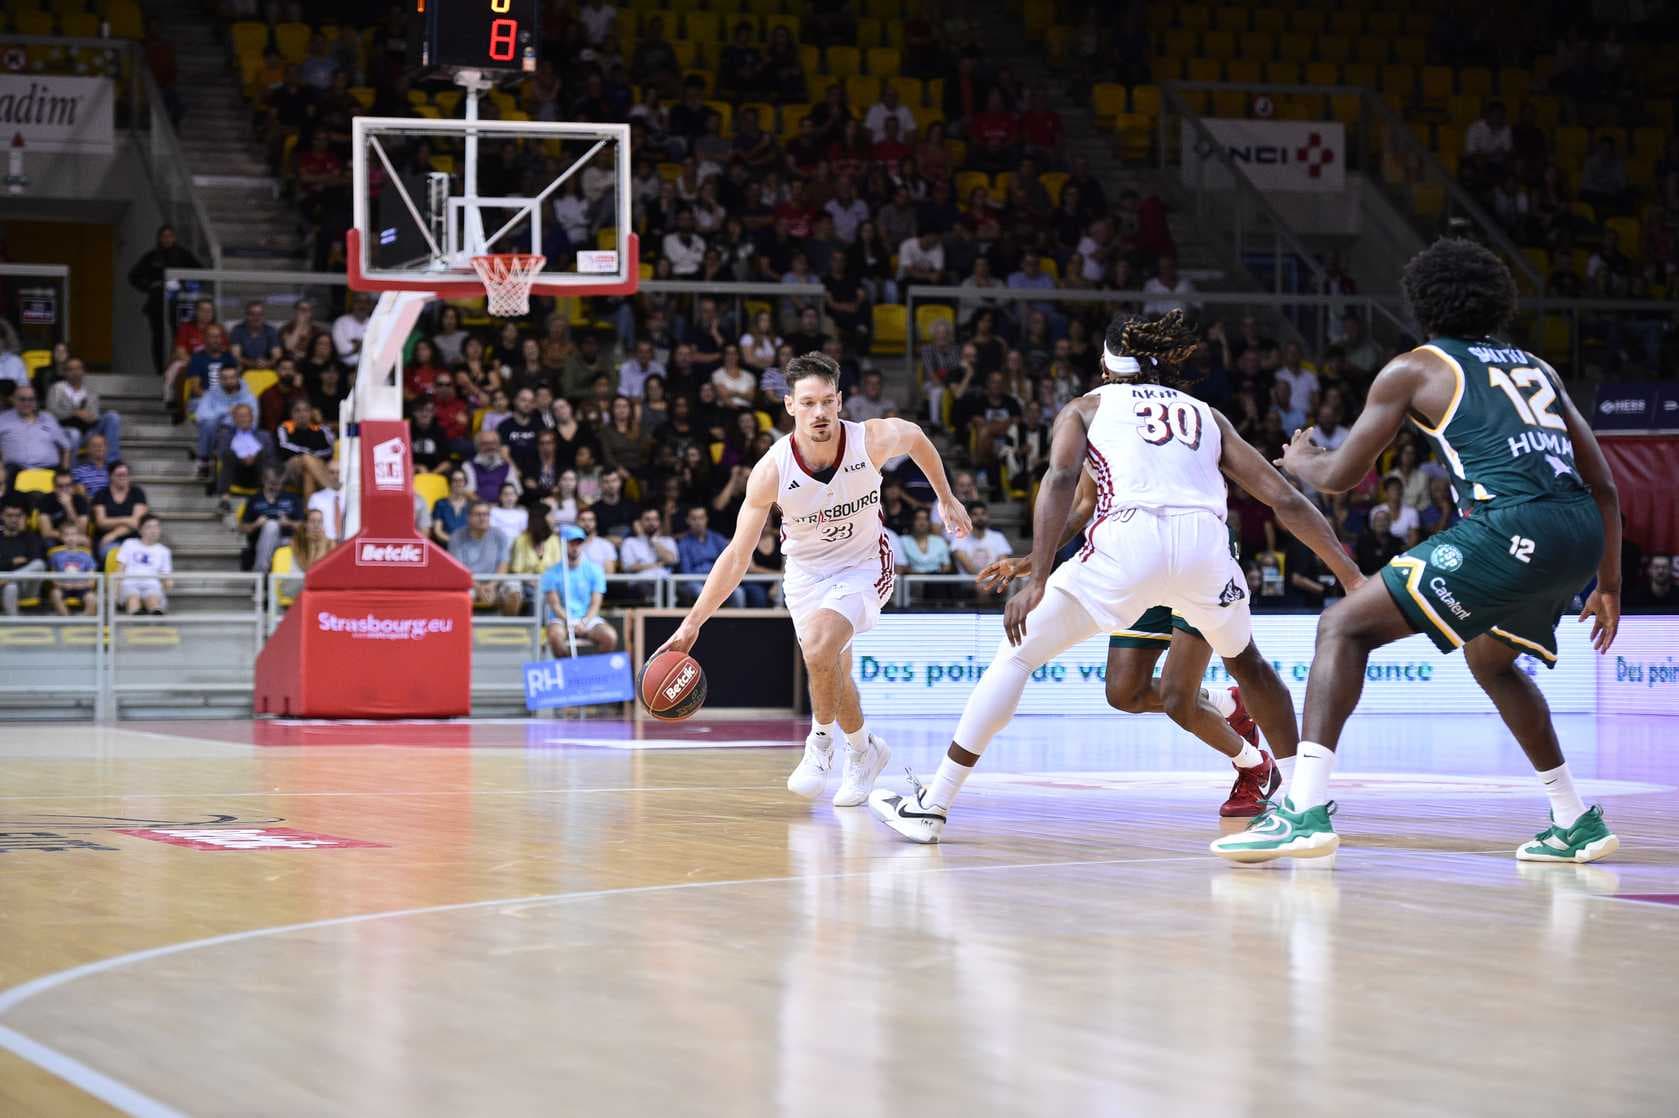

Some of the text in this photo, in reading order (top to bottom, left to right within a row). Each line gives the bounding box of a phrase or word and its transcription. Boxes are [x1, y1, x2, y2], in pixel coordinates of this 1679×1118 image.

[489, 19, 517, 60] 8
[1488, 366, 1567, 431] 12
[1133, 401, 1202, 451] 30
[851, 462, 866, 472] LCR
[821, 522, 853, 542] 23
[1509, 535, 1535, 563] 12
[1430, 577, 1471, 620] Catalent
[318, 611, 453, 641] Strasbourg.eu
[527, 662, 565, 697] RH
[666, 666, 696, 699] Betclic
[861, 655, 913, 682] Des
[927, 655, 990, 688] poin
[1367, 665, 1433, 682] ance
[1616, 656, 1643, 682] Des
